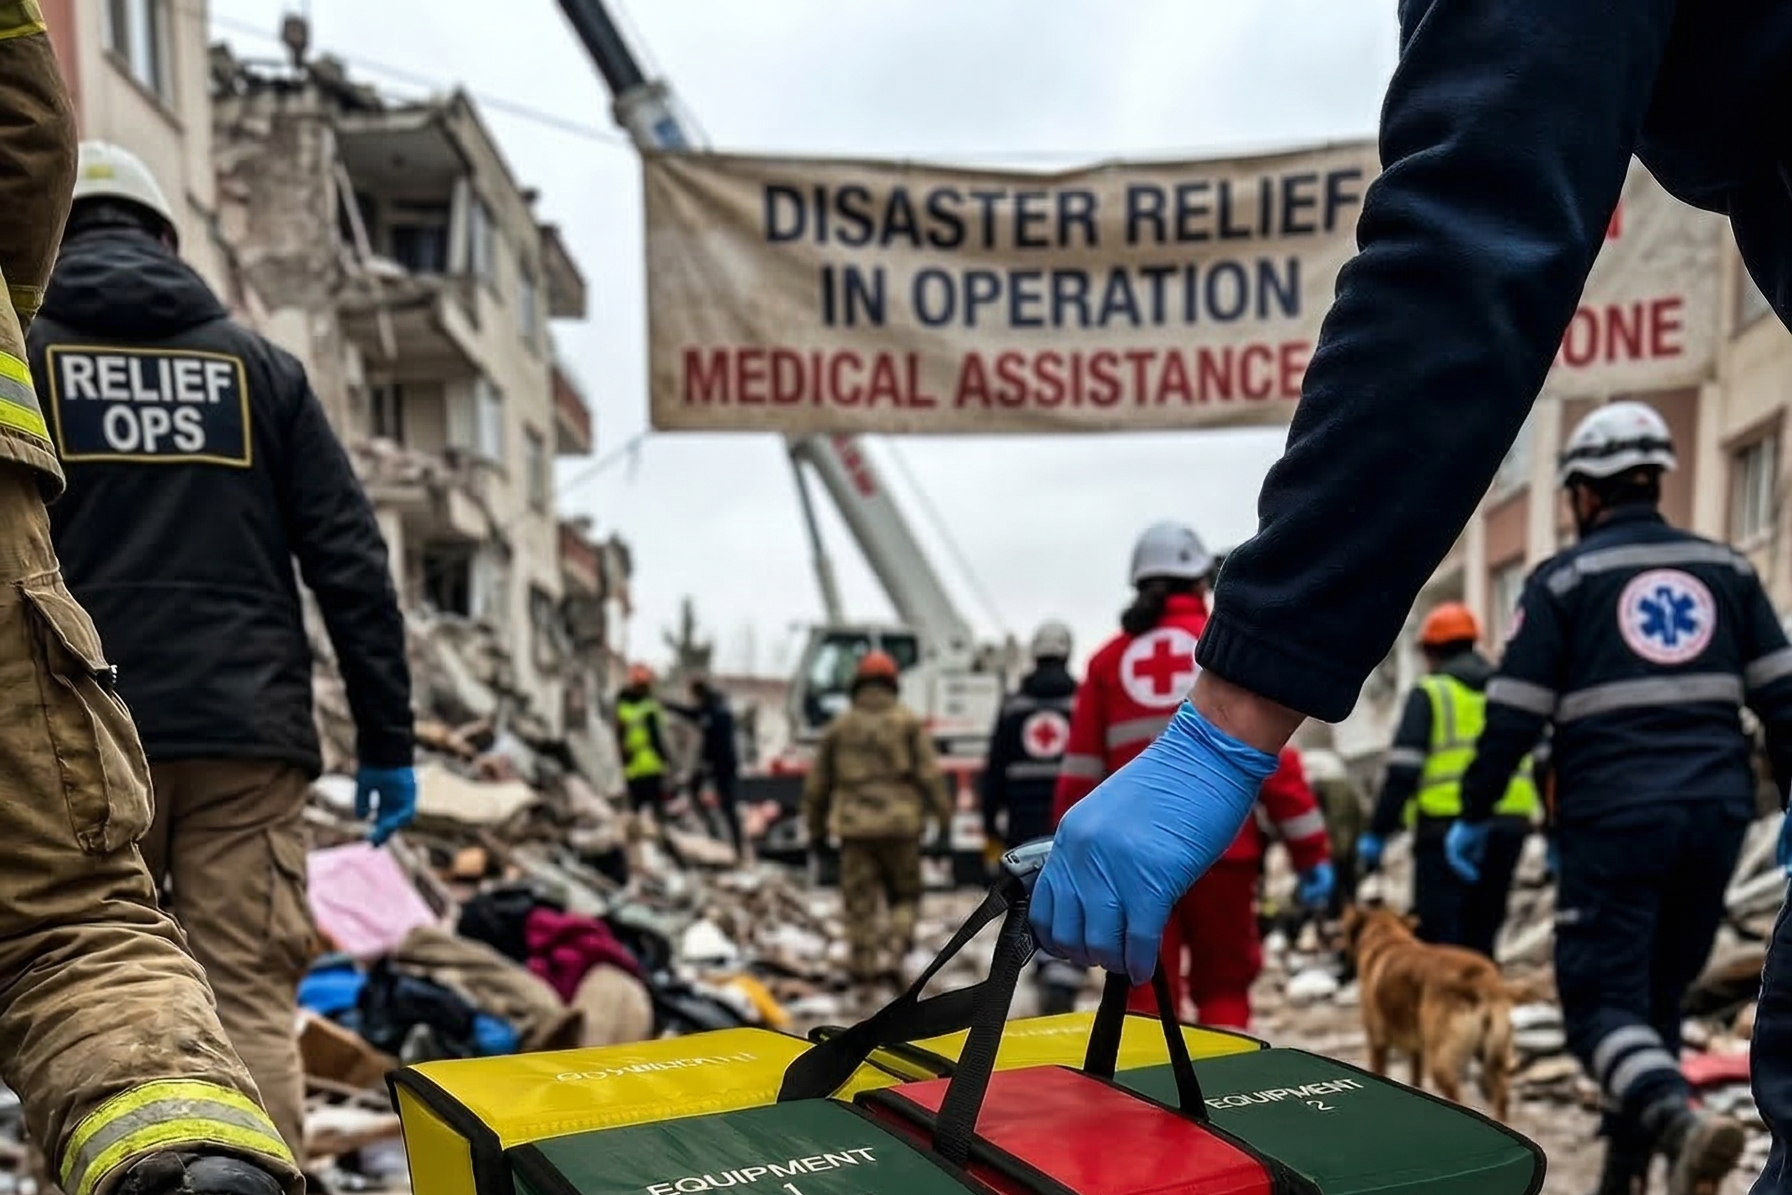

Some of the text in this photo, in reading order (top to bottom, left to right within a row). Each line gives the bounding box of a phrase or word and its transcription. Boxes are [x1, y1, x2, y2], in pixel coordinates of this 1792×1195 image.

[765, 169, 1362, 250] DISASTER RELIEF
[821, 258, 1300, 328] IN OPERATION
[1553, 297, 1684, 369] ONE
[61, 355, 232, 403] RELIEF
[682, 341, 1312, 408] MEDICAL ASSISTANCE
[103, 404, 206, 452] OPS
[1203, 1078, 1364, 1110] EQUIPMENT
[1306, 1100, 1335, 1112] 2
